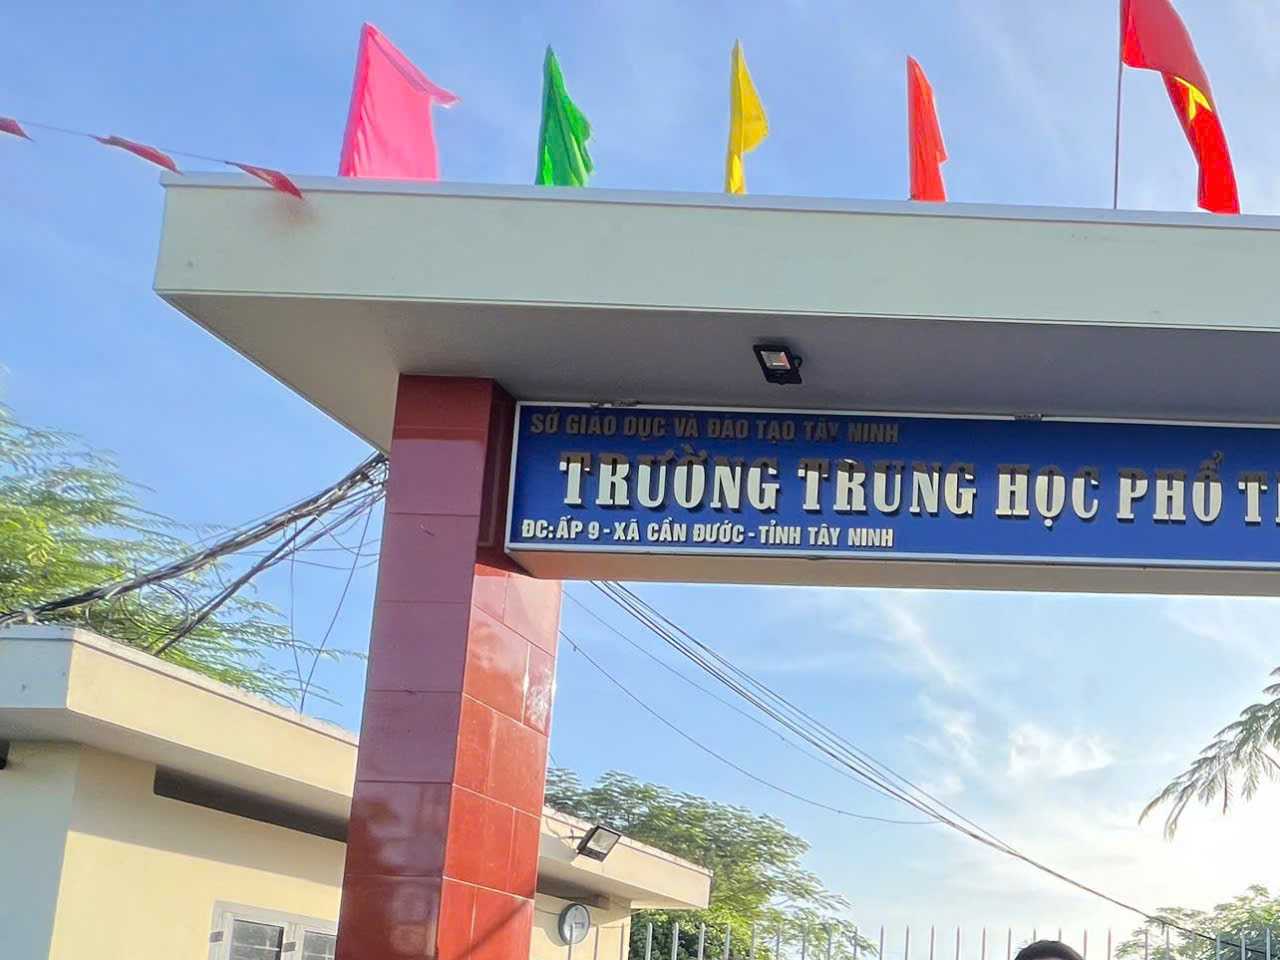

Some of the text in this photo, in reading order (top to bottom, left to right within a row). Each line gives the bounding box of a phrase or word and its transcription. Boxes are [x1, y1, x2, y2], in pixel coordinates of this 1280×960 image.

[756, 419, 796, 443] TẠO
[803, 417, 839, 442] TÂY
[848, 421, 898, 443] NINH
[559, 443, 781, 511] TRƯỜNG
[798, 457, 977, 517] TRUNG
[995, 463, 1100, 529] HỌC
[1116, 450, 1224, 523] PHỔ
[647, 516, 687, 541] CẦN
[808, 523, 841, 546] TÂY
[848, 527, 893, 547] NINH
